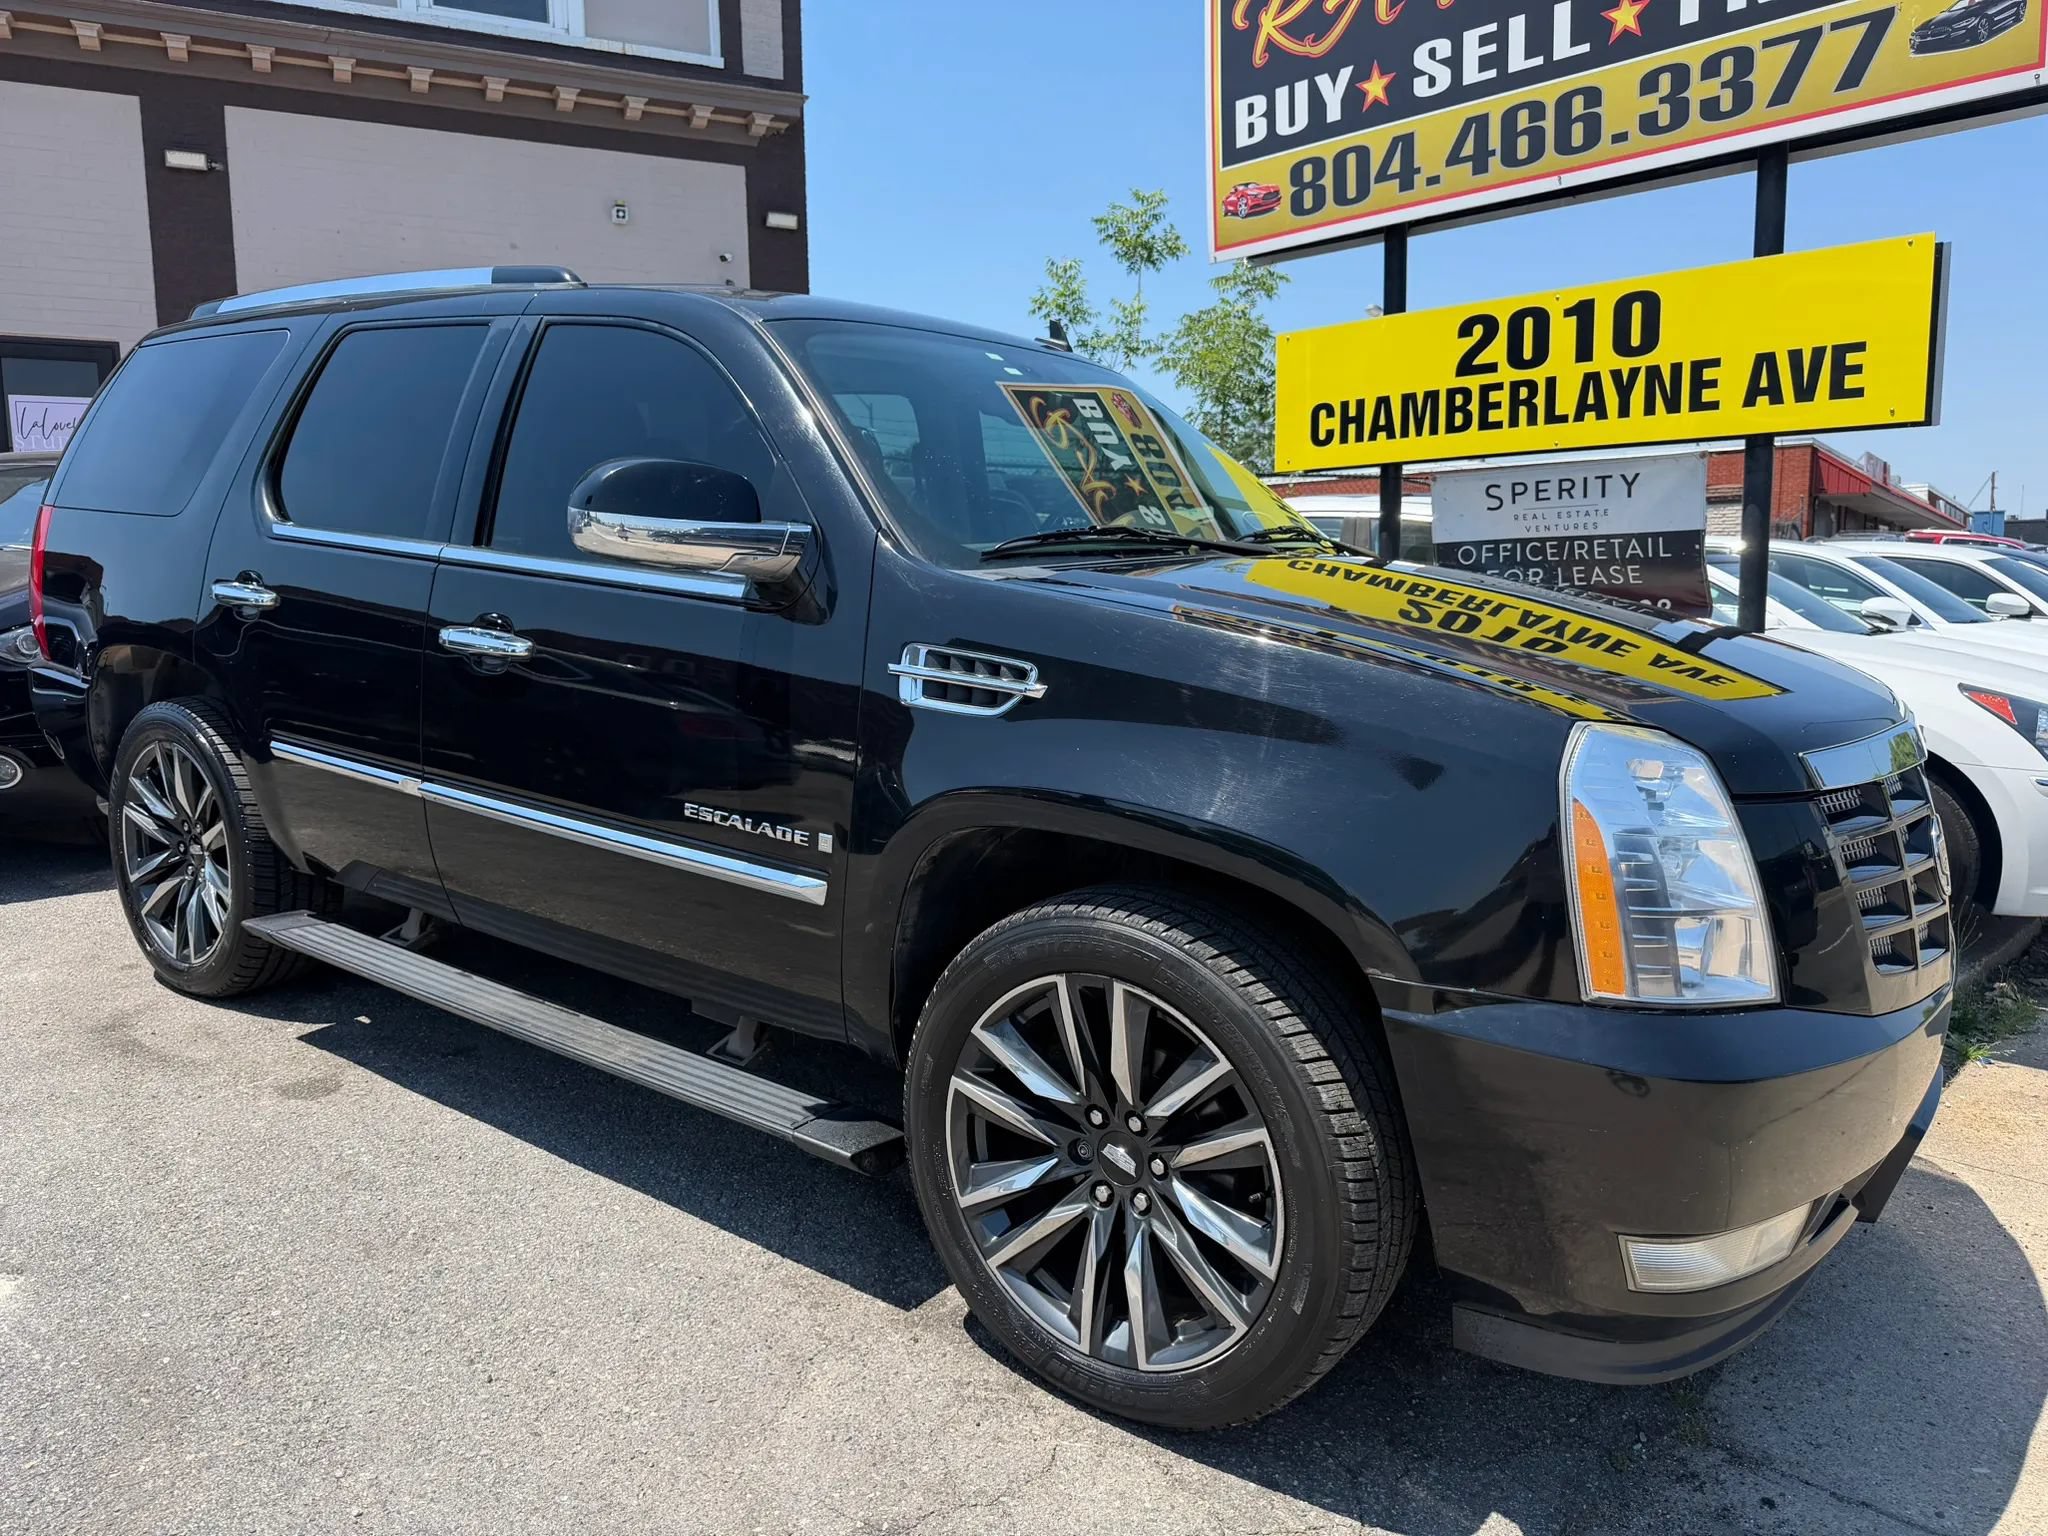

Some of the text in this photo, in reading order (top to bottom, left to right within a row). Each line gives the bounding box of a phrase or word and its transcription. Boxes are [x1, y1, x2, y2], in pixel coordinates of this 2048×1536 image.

[1235, 65, 1354, 149] BUY
[1413, 0, 1591, 98] SELL
[1289, 7, 1898, 217] 804.466.3377
[1455, 290, 1661, 378] 2010
[1310, 341, 1867, 448] CHAMBERLAYNE AVE
[1485, 472, 1641, 511] SPERITY
[1513, 508, 1609, 521] REAL ESTATE
[1525, 522, 1600, 533] VENTURES
[1457, 537, 1672, 565] OFFICE/RETAIL
[1557, 565, 1643, 586] LEASE
[684, 802, 810, 847] ESCALADE
